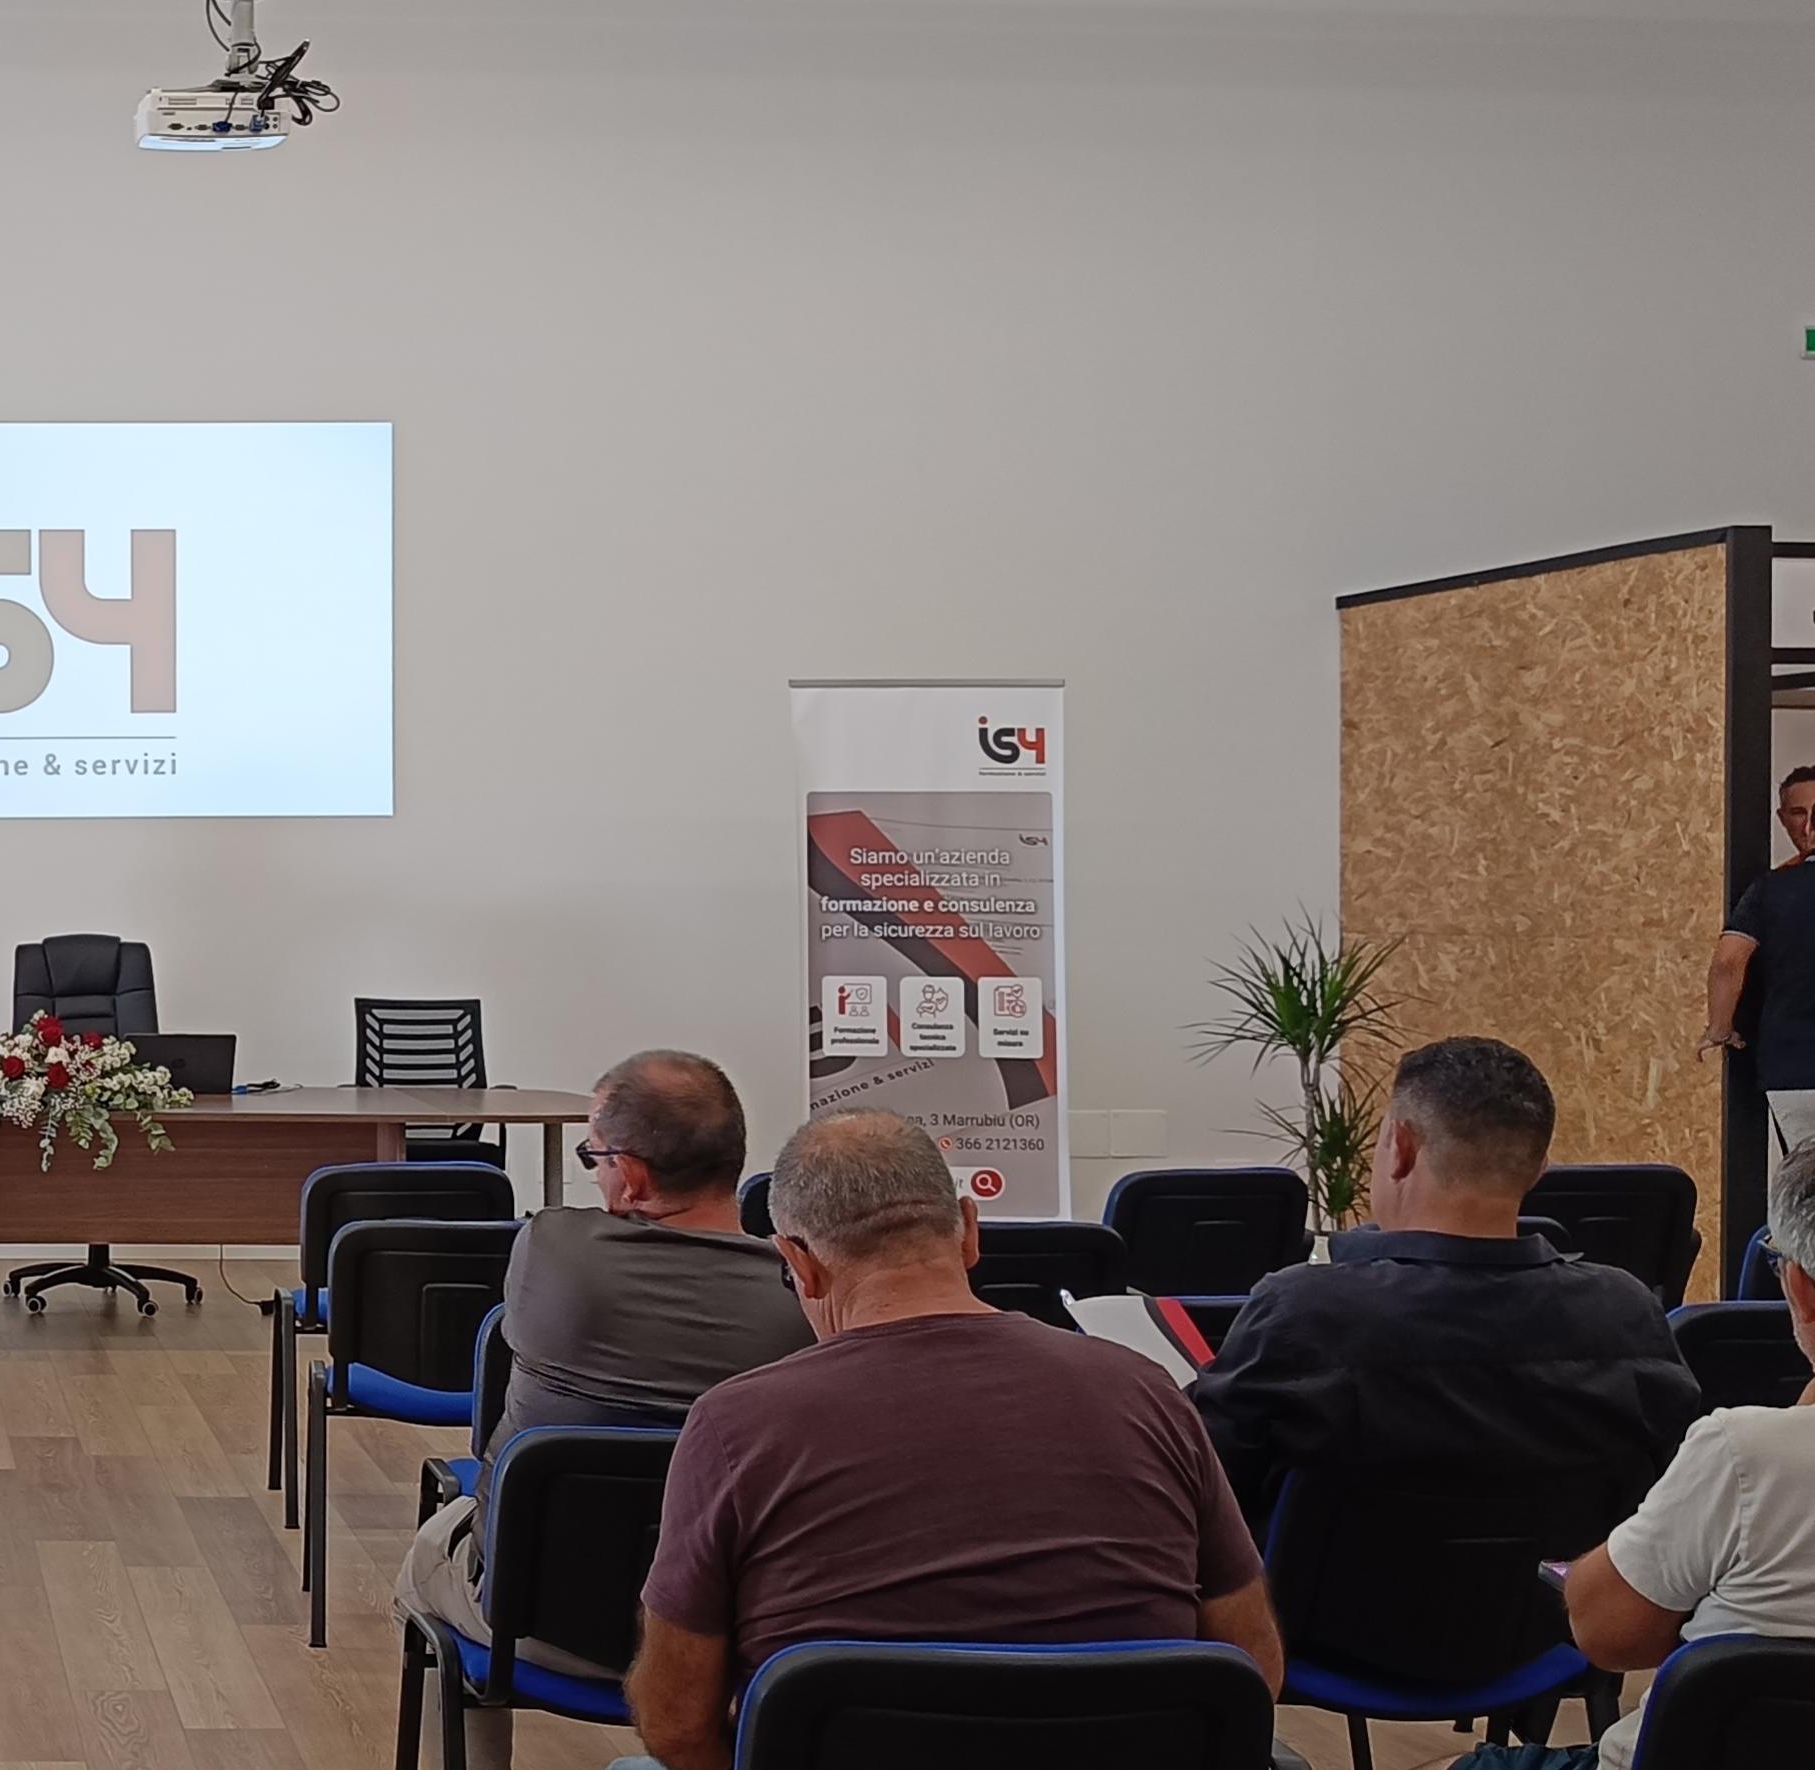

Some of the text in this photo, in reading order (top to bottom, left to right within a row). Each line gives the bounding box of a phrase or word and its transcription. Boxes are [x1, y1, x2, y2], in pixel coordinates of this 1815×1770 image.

[43, 753, 62, 776] &
[74, 752, 178, 776] servizi
[849, 847, 908, 864] Siamo
[860, 871, 1001, 890] specializzata in
[820, 896, 1036, 913] formazione e consulenza
[821, 922, 1041, 939] per la sicurezza sul lavoro
[872, 1075, 884, 1086] &
[887, 1058, 935, 1081] servizi
[929, 1113, 939, 1126] 3
[942, 1113, 1006, 1127] Marrubiu
[1009, 1114, 1041, 1130] (OR)
[955, 1137, 1045, 1151] 366 2121360
